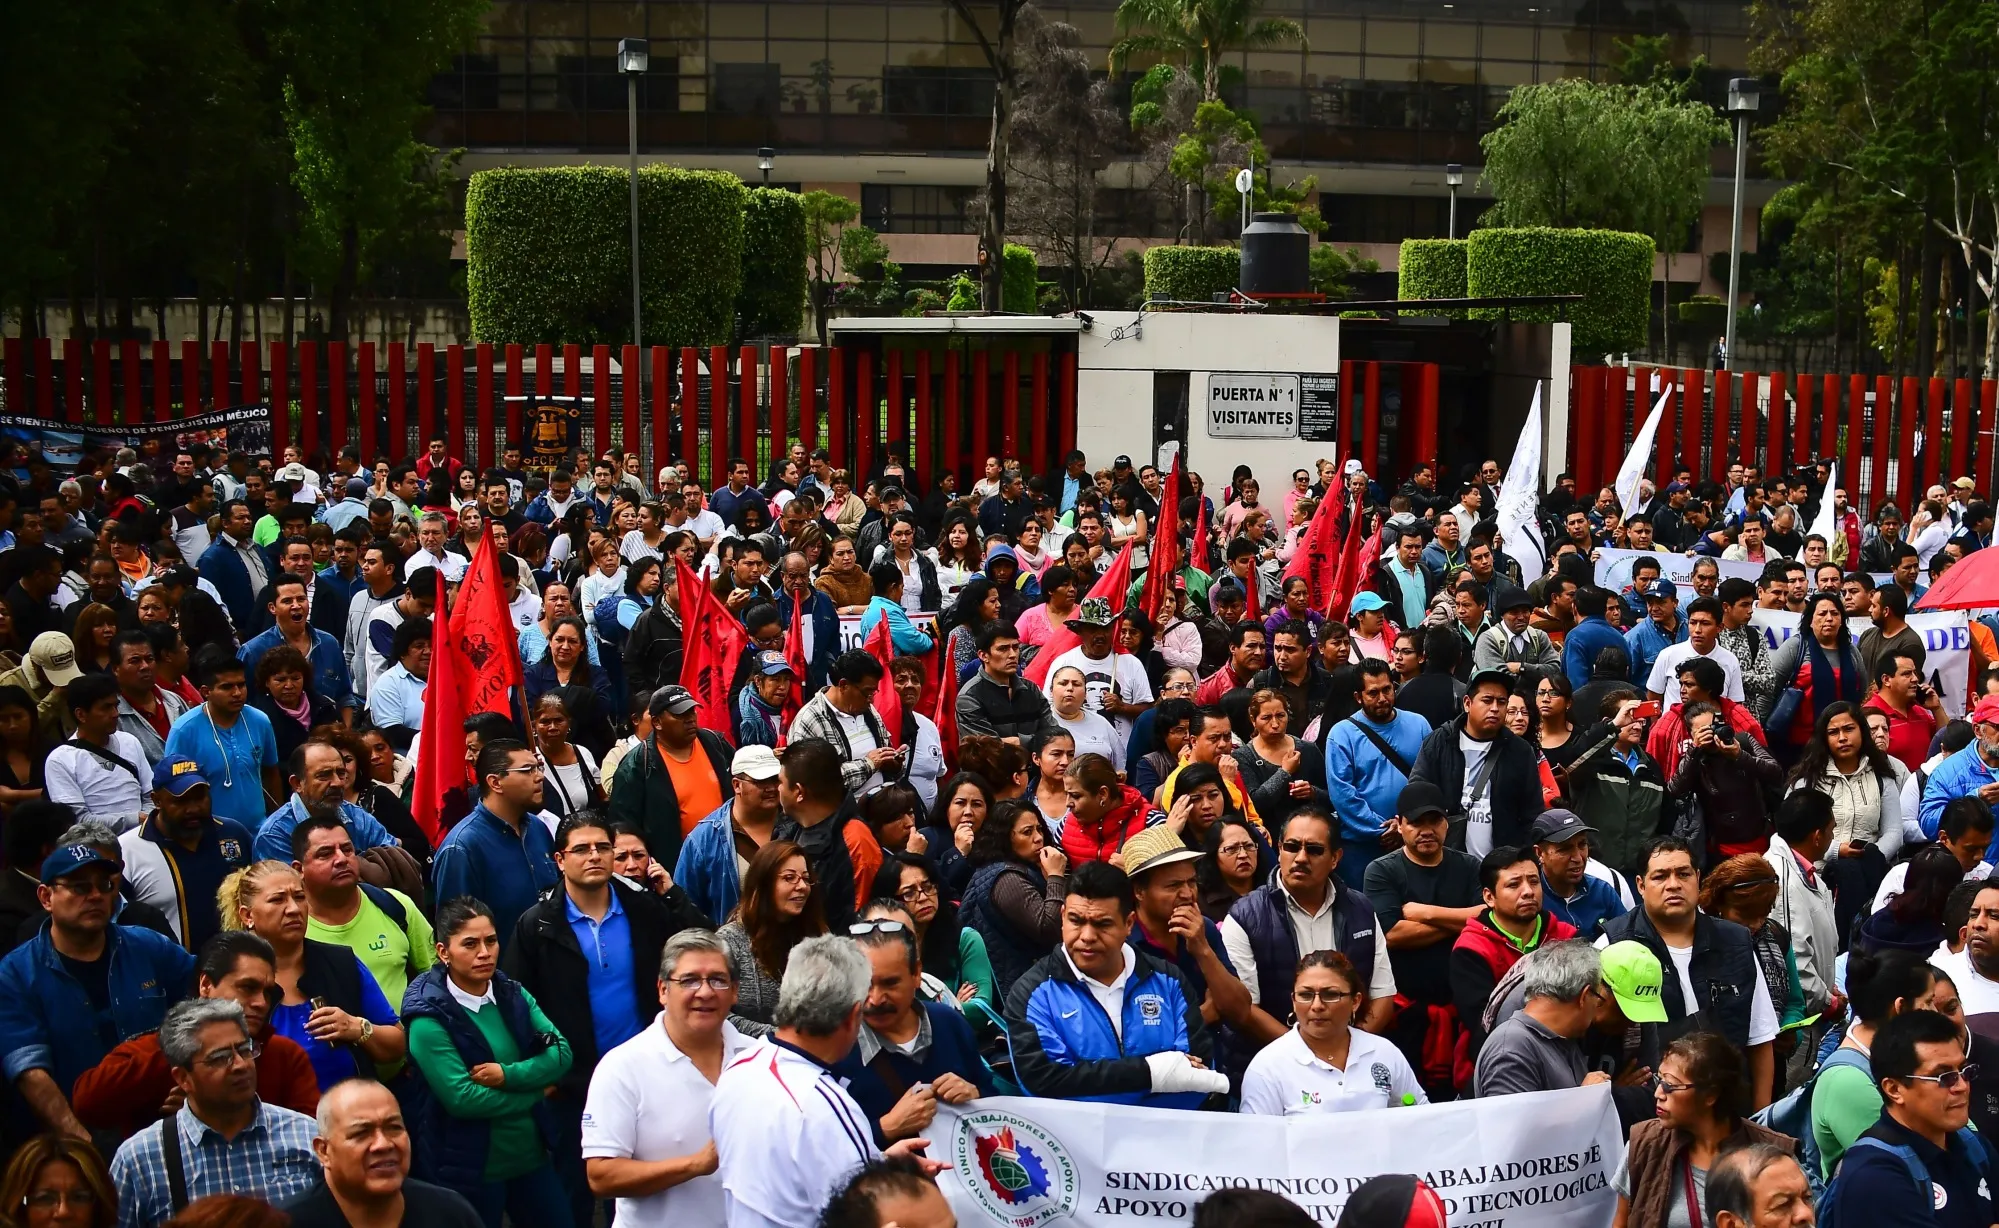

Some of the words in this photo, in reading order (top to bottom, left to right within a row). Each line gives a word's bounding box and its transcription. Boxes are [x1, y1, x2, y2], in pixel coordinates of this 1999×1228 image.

[1212, 387, 1264, 401] PUERTA
[1287, 389, 1294, 402] 1
[0, 415, 12, 424] SE
[15, 416, 62, 429] SIENTEN
[64, 423, 84, 431] LOS
[226, 408, 268, 421] MÉXICO
[1212, 410, 1293, 425] VISITANTES
[1926, 626, 1970, 651] DE
[172, 761, 198, 776] NIKE
[1635, 985, 1659, 996] UTN
[1047, 1140, 1061, 1153] DE
[1106, 1171, 1250, 1191] SINDICATO
[1255, 1177, 1339, 1195] UNICO
[1424, 1153, 1579, 1189] ABAJADORES
[1463, 1170, 1608, 1214] TECNOLOGICA
[1095, 1196, 1187, 1218] APOYO
